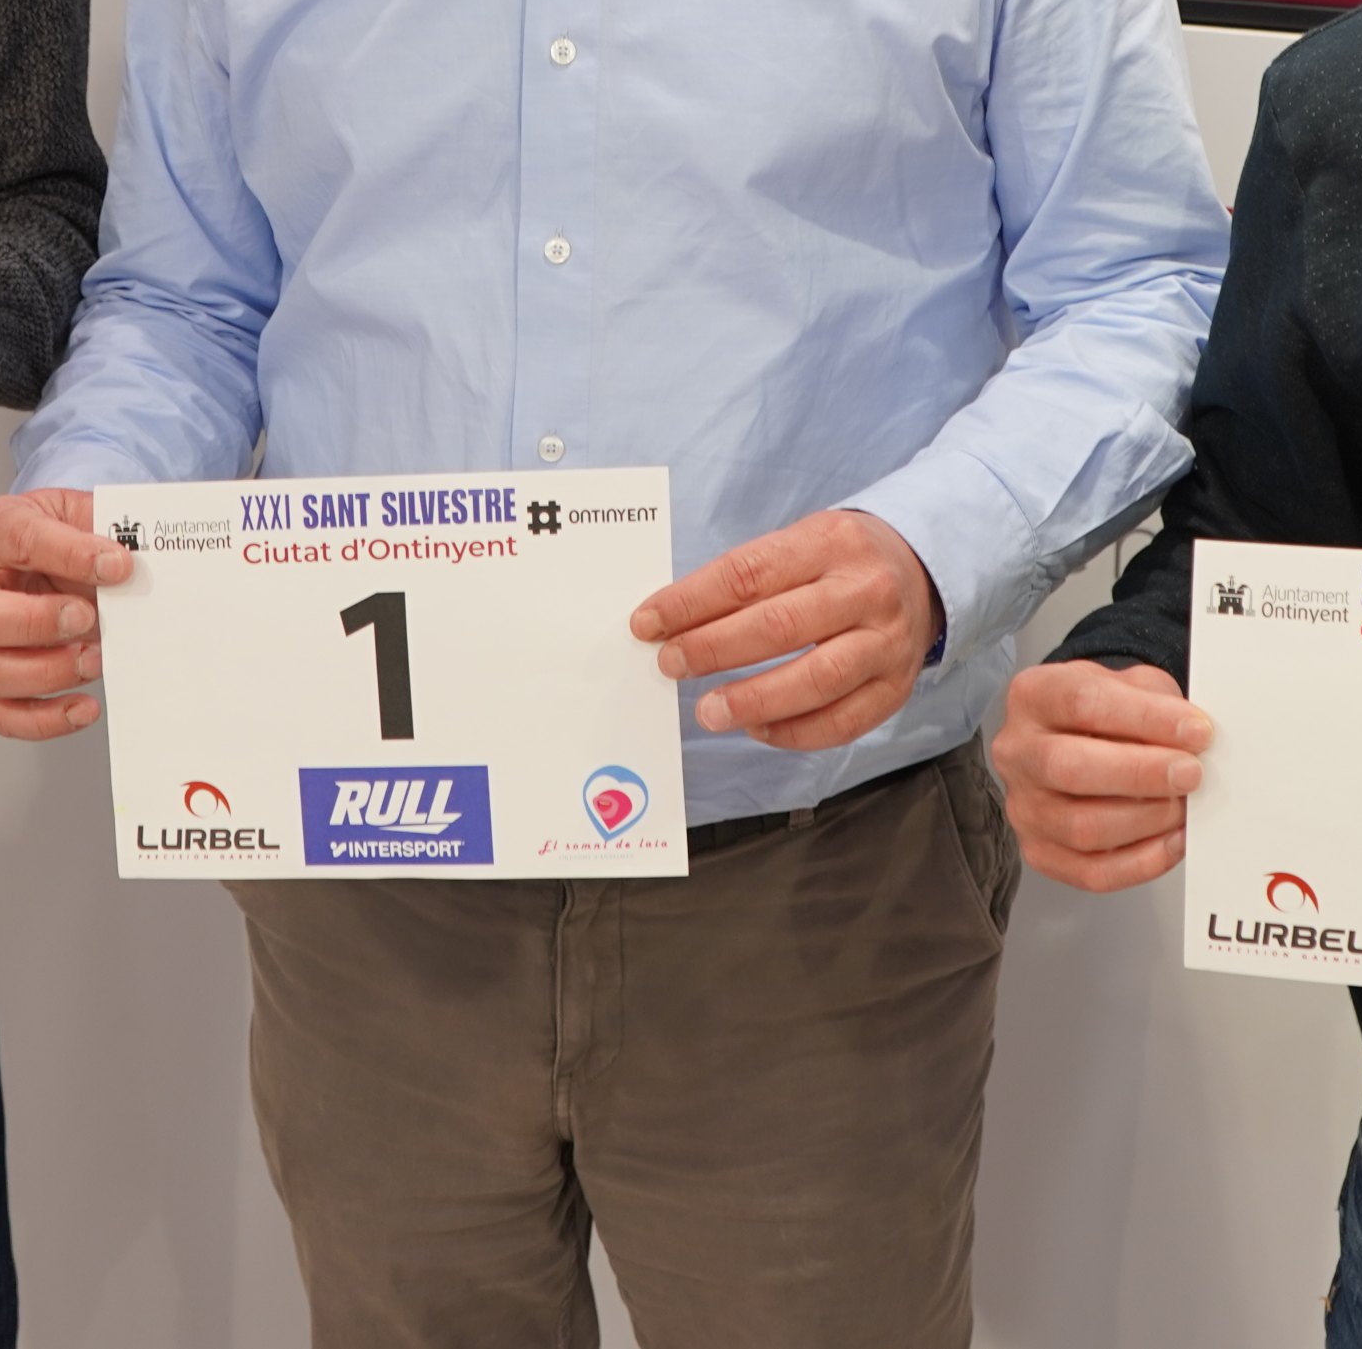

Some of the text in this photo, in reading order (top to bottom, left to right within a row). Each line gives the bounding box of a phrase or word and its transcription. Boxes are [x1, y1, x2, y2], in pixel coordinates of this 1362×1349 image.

[240, 488, 517, 531] XXXI SANT SILVESTRE
[569, 507, 658, 524] ONTINYENT
[154, 518, 231, 536] Ajuntament
[154, 534, 232, 552] Ontinyent
[242, 536, 518, 564] Ciutat d'Ontinyent
[1262, 584, 1349, 606] Ajuntament
[1261, 602, 1349, 624] Ontinyent
[340, 592, 414, 740] 1
[329, 780, 462, 827] RULL
[137, 825, 280, 850] LURBEL
[348, 840, 462, 858] INTERSPORT
